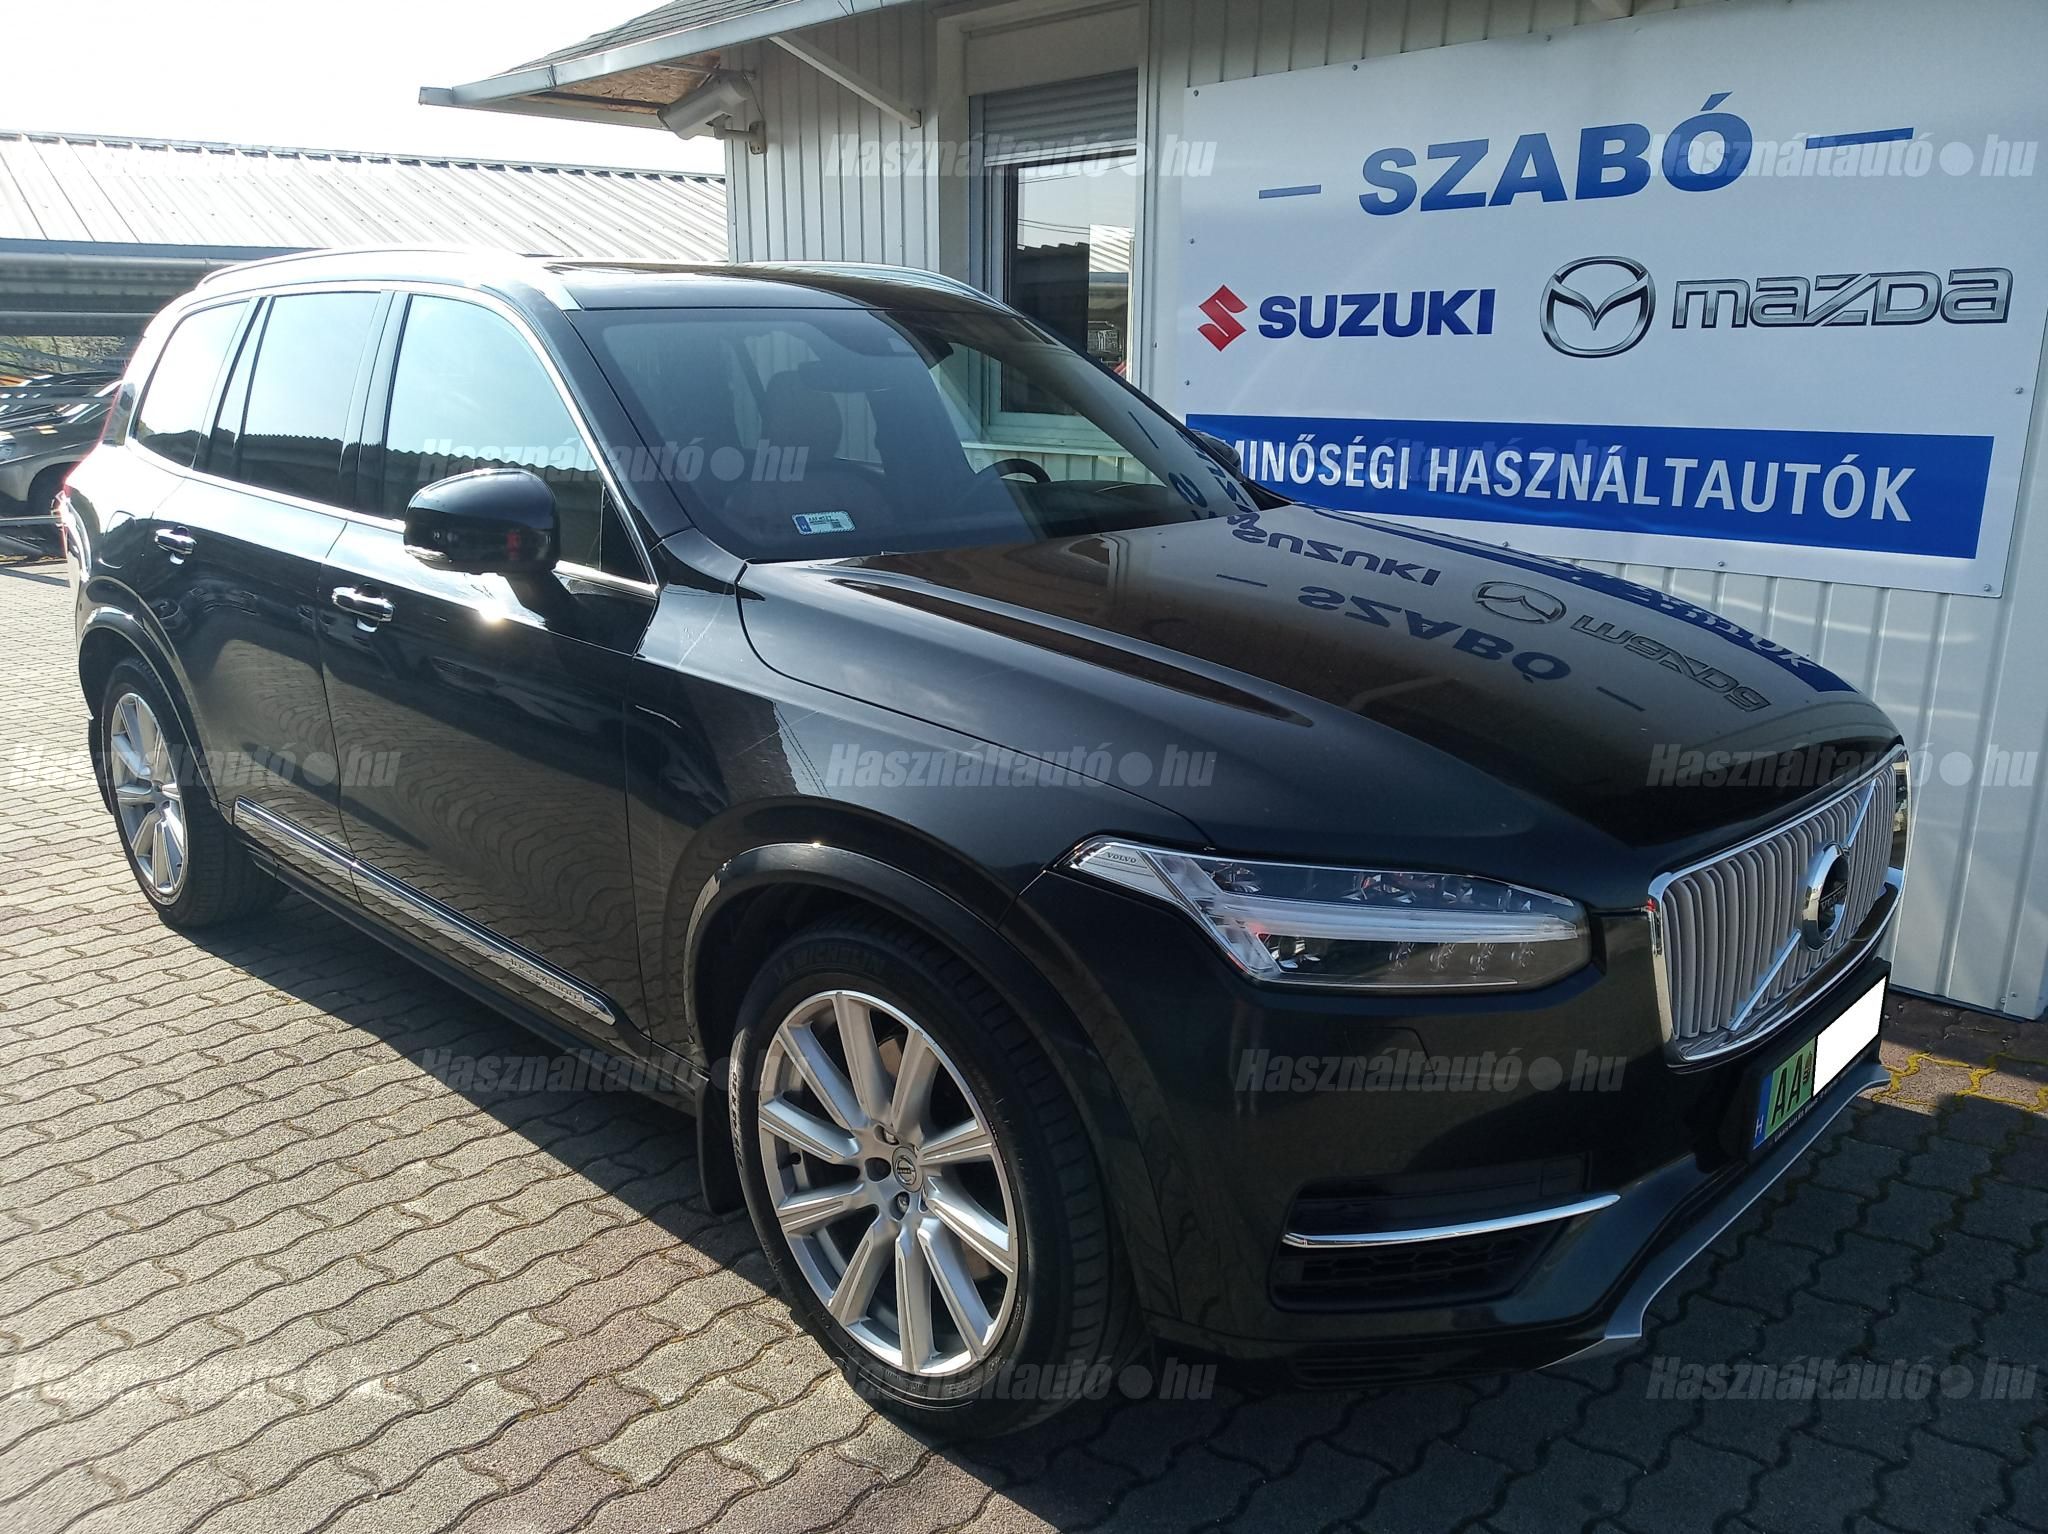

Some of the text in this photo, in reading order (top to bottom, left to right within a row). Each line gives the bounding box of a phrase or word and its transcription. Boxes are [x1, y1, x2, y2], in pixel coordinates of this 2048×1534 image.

[1358, 91, 1754, 216] SZABÓ
[1257, 288, 1496, 340] SUZUKI
[1427, 444, 1917, 523] HASZNÁLTAUTÓK
[1106, 852, 1137, 864] VOLVO
[1754, 1114, 1765, 1139] H
